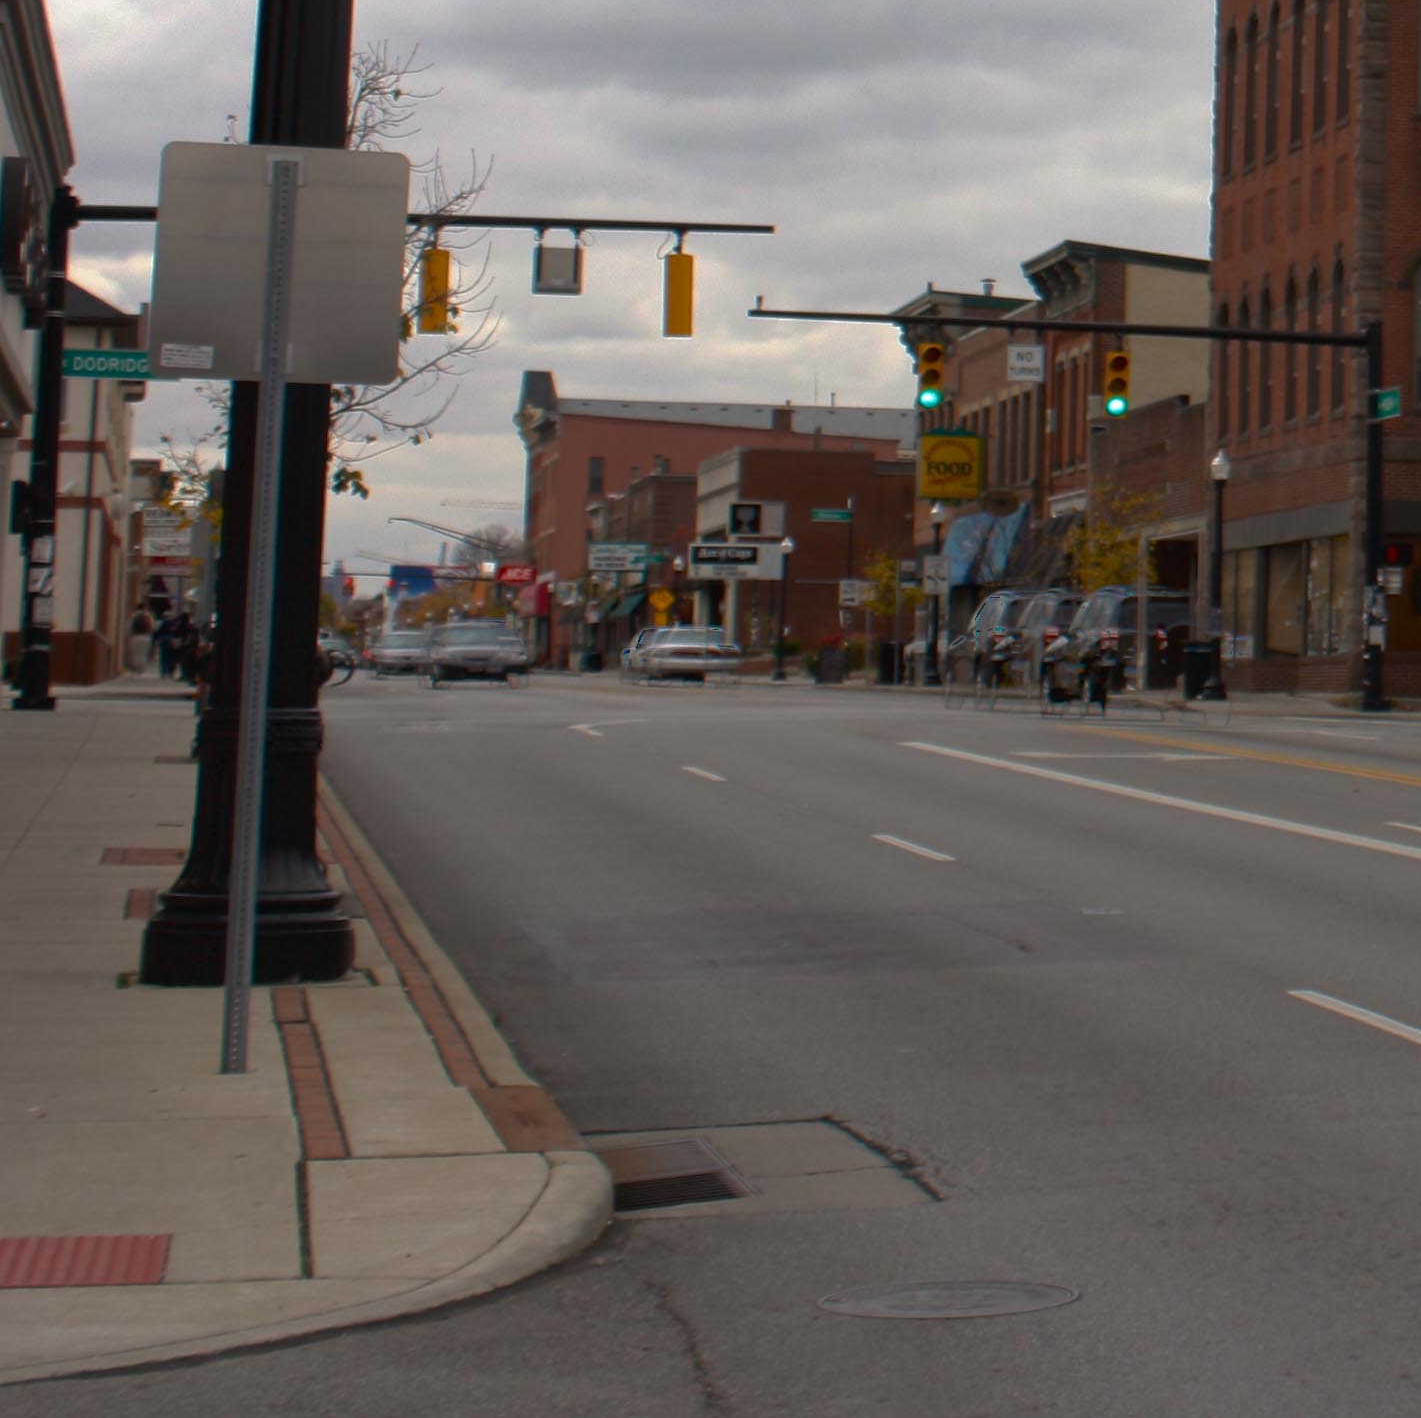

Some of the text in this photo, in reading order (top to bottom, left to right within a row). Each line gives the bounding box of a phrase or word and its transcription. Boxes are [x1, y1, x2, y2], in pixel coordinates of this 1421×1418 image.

[72, 355, 149, 374] DODRIDG
[927, 461, 973, 477] FOOD
[499, 567, 533, 582] ACE
